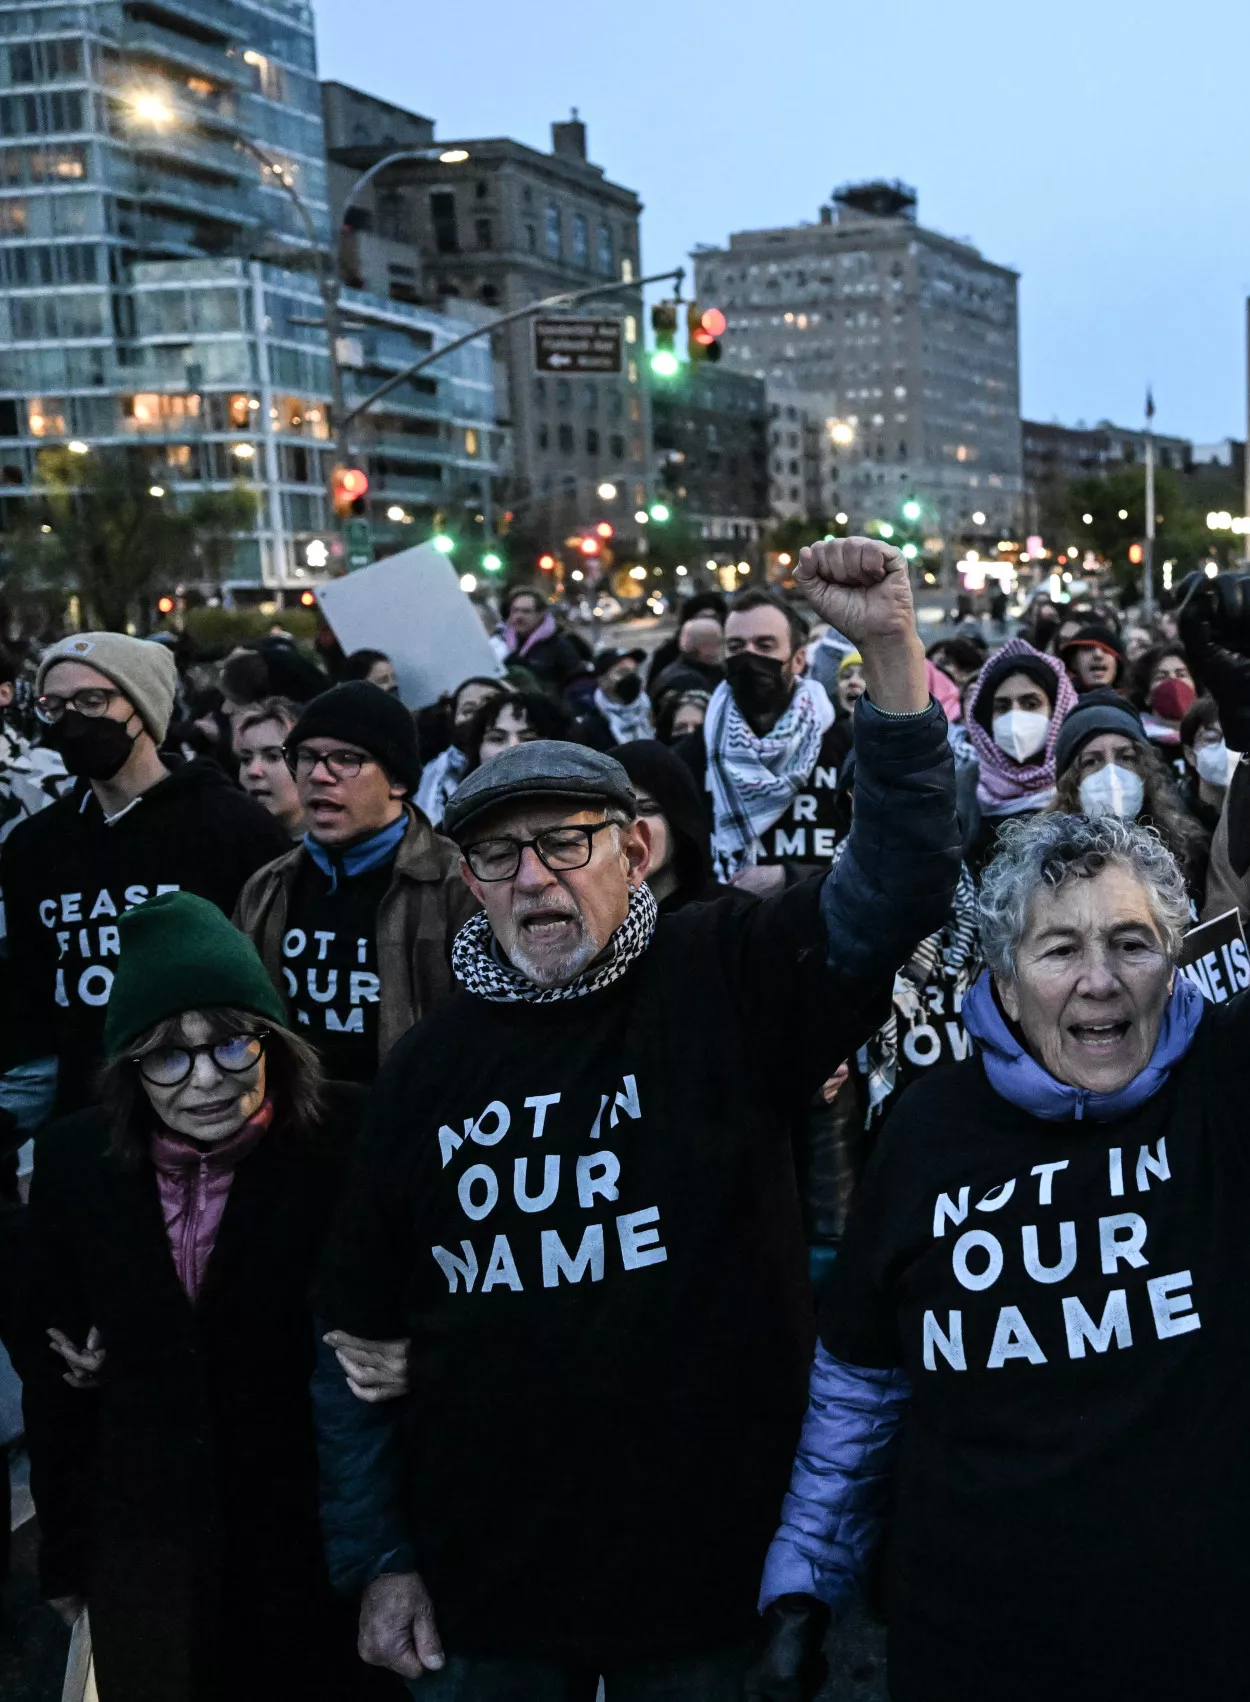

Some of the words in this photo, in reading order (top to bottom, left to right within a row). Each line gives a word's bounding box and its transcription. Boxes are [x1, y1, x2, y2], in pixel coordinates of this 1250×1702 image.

[1221, 938, 1250, 993] IS
[438, 1092, 562, 1169] NOT
[589, 1074, 642, 1139] IN
[457, 1150, 621, 1221] OUR
[1109, 1136, 1172, 1197] IN
[431, 1205, 668, 1293] NAME
[952, 1212, 1150, 1291] OUR
[923, 1269, 1201, 1371] NAME
